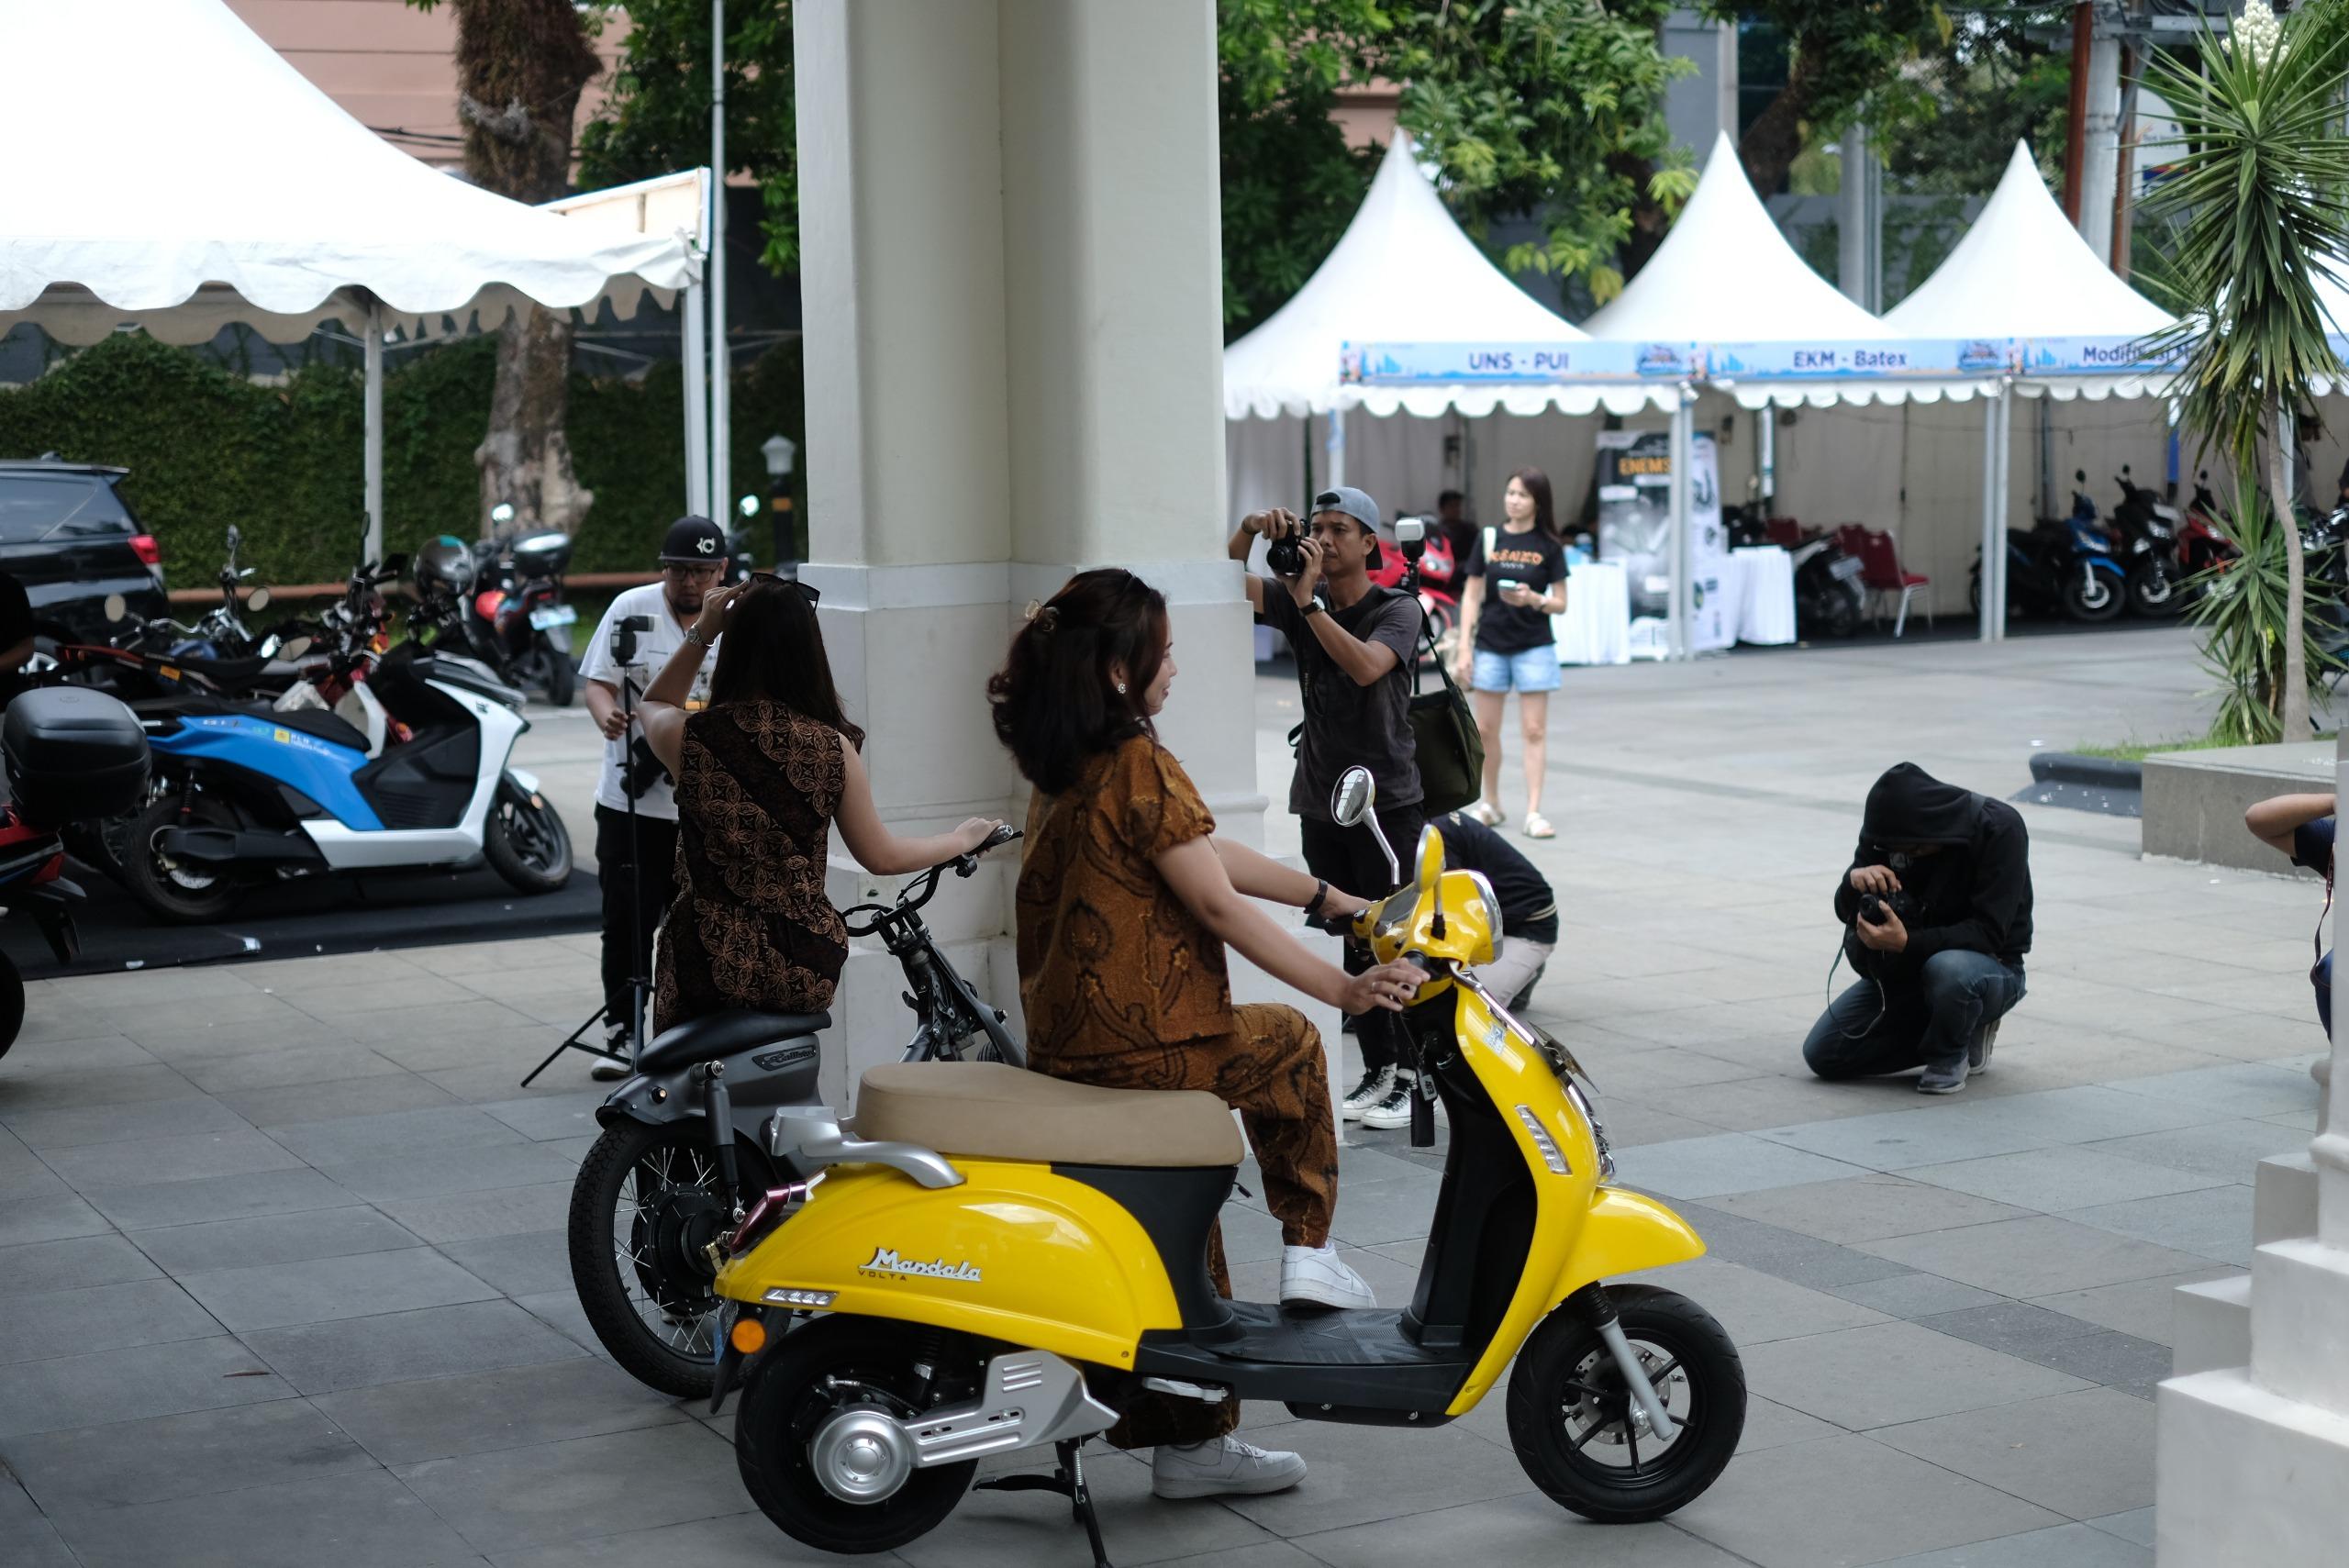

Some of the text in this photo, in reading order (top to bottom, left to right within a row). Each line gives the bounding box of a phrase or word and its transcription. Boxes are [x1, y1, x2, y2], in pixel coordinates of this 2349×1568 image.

[1469, 352, 1512, 370] UNS
[1534, 351, 1569, 369] PUI
[1794, 350, 1835, 367] EKM
[1854, 350, 1907, 366] Batex
[859, 1247, 982, 1282] Mandala
[858, 1270, 907, 1281] VOLTA
